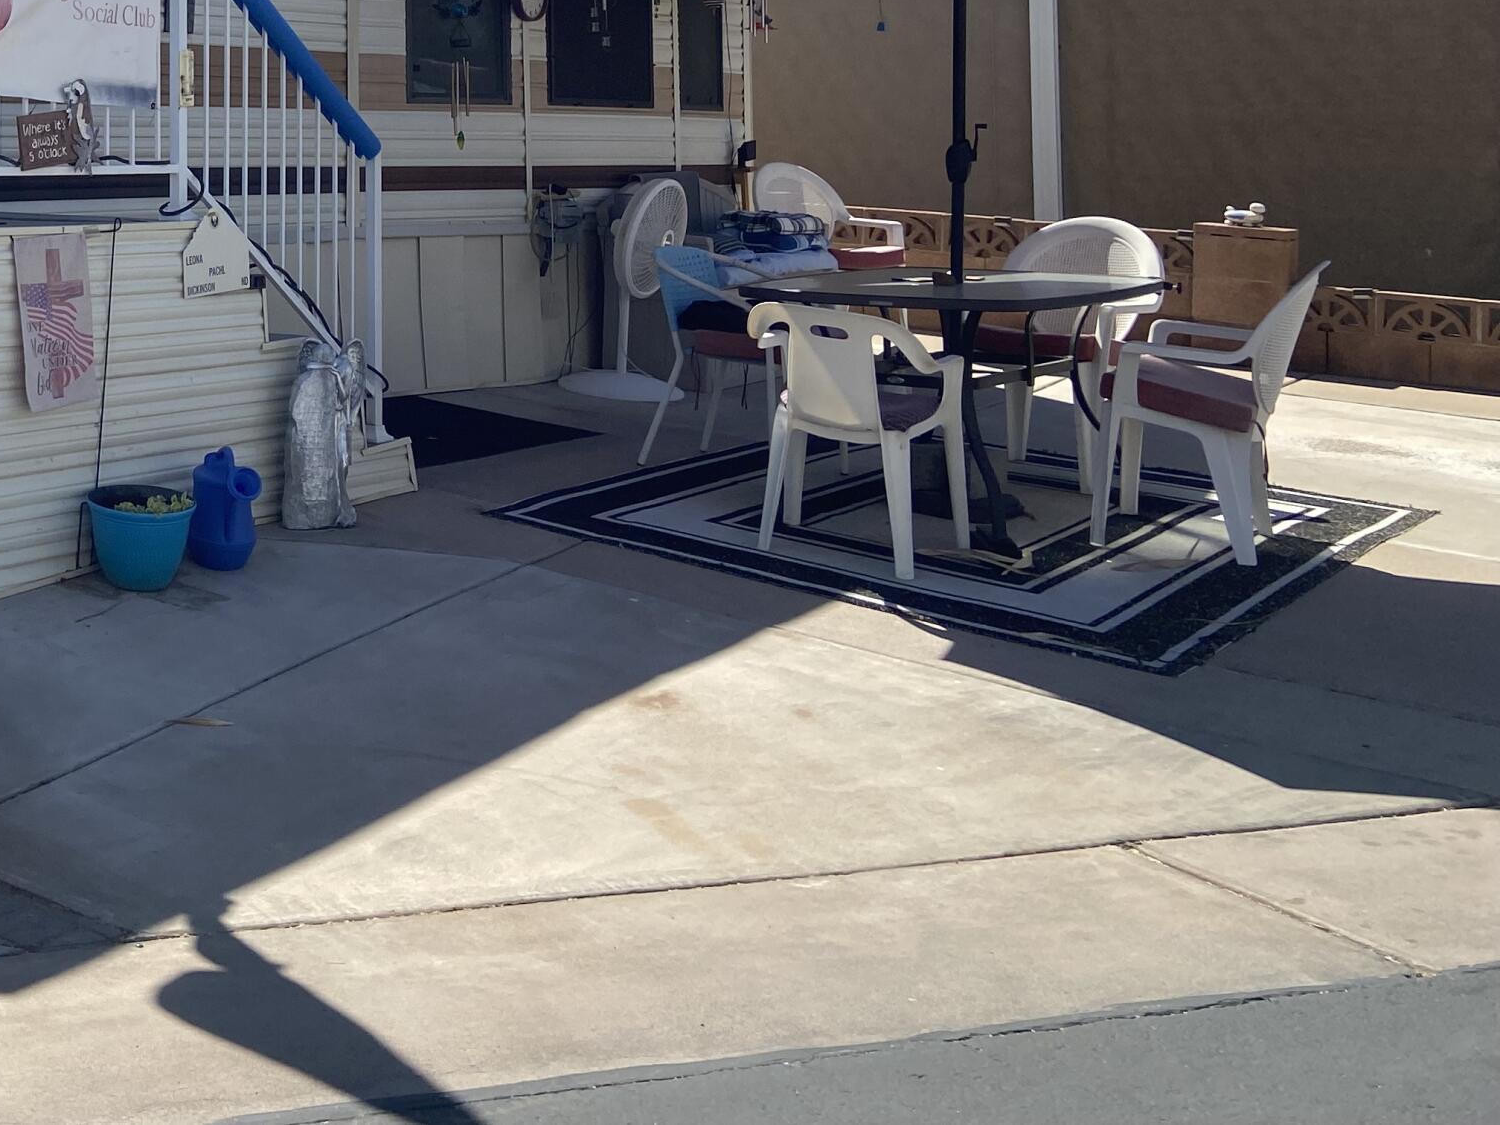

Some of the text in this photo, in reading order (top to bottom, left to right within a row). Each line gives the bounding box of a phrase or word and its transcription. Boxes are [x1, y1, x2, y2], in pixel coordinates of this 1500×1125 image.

[72, 0, 156, 28] Social Club
[22, 123, 51, 136] Where
[31, 134, 59, 149] always
[185, 254, 204, 266] LEONA
[208, 265, 225, 277] PACHL
[187, 282, 216, 296] DICKINSON
